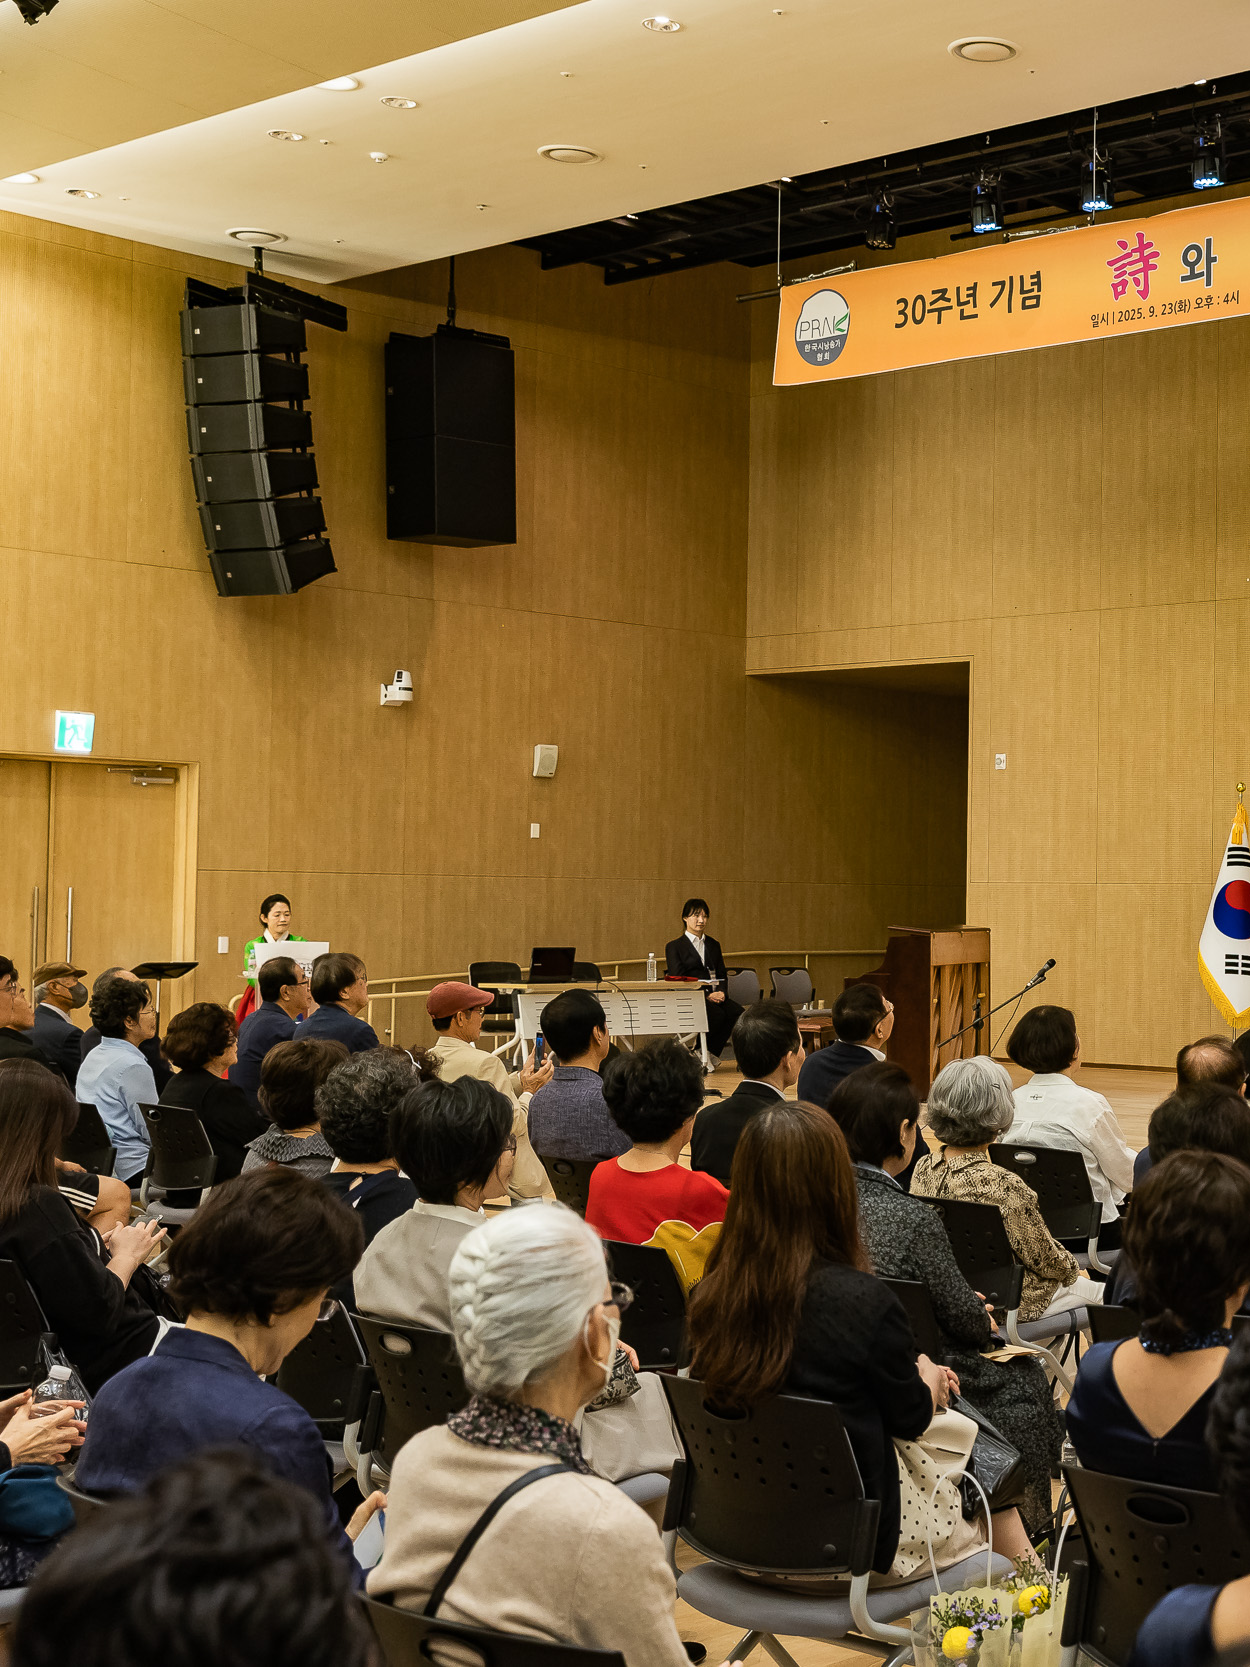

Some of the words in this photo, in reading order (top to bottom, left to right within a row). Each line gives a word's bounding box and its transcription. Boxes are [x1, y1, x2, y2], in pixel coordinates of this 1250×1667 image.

[894, 282, 979, 329] 30주년
[989, 270, 1042, 314] 기념
[1090, 311, 1109, 328] 일시
[1118, 308, 1146, 323] 2025.
[1148, 306, 1158, 318] 9.
[1161, 299, 1191, 316] 23(화)
[1194, 295, 1214, 310] 오후
[804, 339, 841, 353] 한국시낭송가
